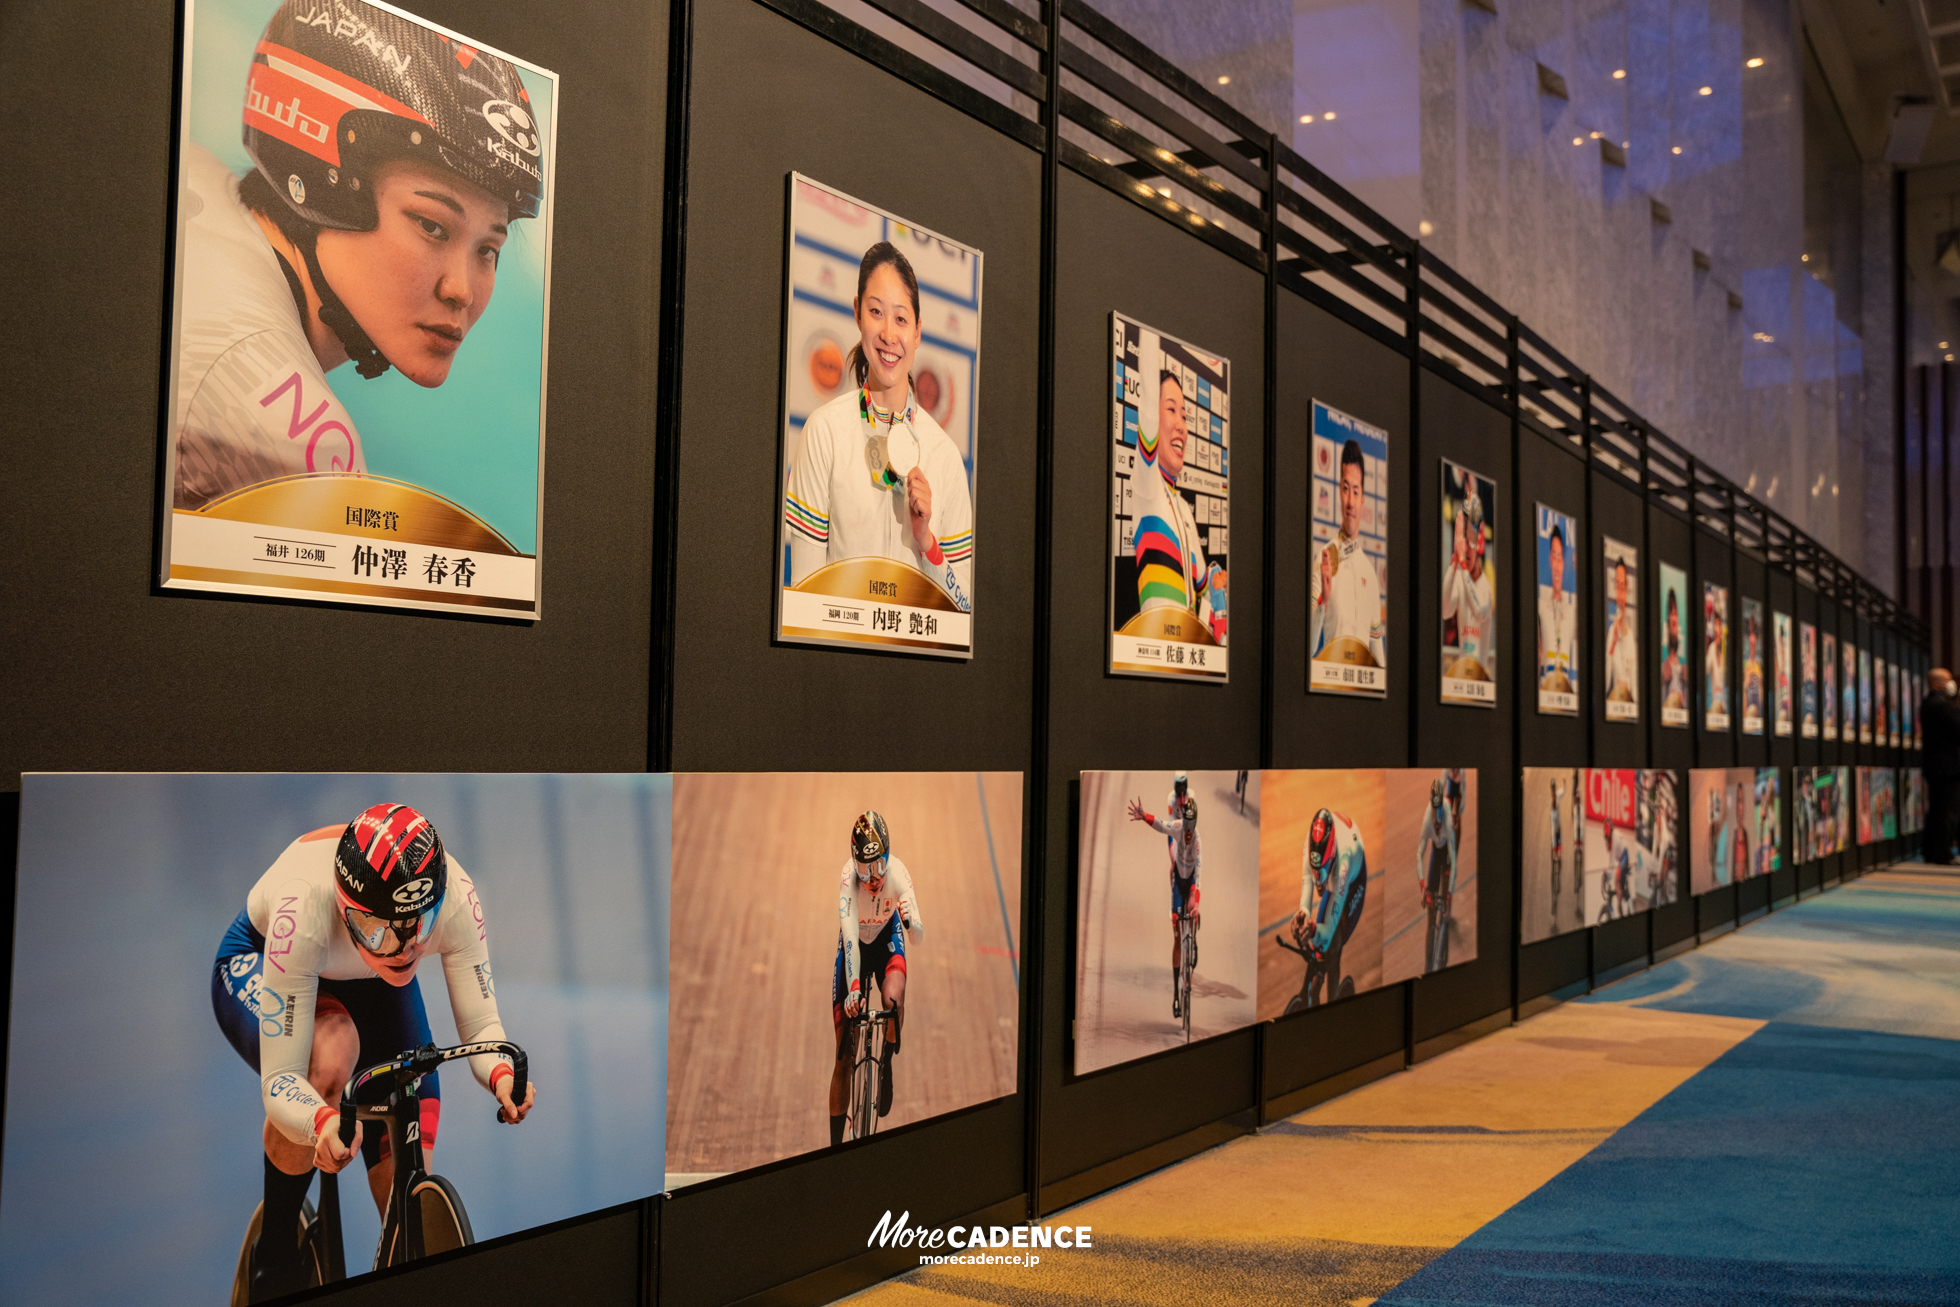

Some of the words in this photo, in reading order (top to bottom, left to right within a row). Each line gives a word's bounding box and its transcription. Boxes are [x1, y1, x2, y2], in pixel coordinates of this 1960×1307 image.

[295, 6, 412, 75] JAPAN
[487, 136, 542, 182] Kabuto
[346, 505, 400, 532] 国際賞
[265, 543, 290, 559] 福井
[295, 547, 326, 563] 126期
[351, 544, 408, 581] 仲澤
[422, 553, 477, 588] 春香
[869, 579, 898, 598] 国際賞
[828, 608, 841, 620] 福岡
[843, 610, 860, 622] 120期
[872, 607, 902, 633] 内野
[909, 612, 938, 636] 艶和
[1166, 644, 1184, 664] 佐藤
[1589, 768, 1631, 823] Chile
[335, 855, 364, 893] JAPAN
[395, 894, 435, 914] Kabuto
[473, 964, 490, 1000] KEIRIN
[284, 994, 297, 1037] KEIRIN
[443, 1042, 501, 1060] LOOK
[286, 1086, 321, 1107] Cyclers
